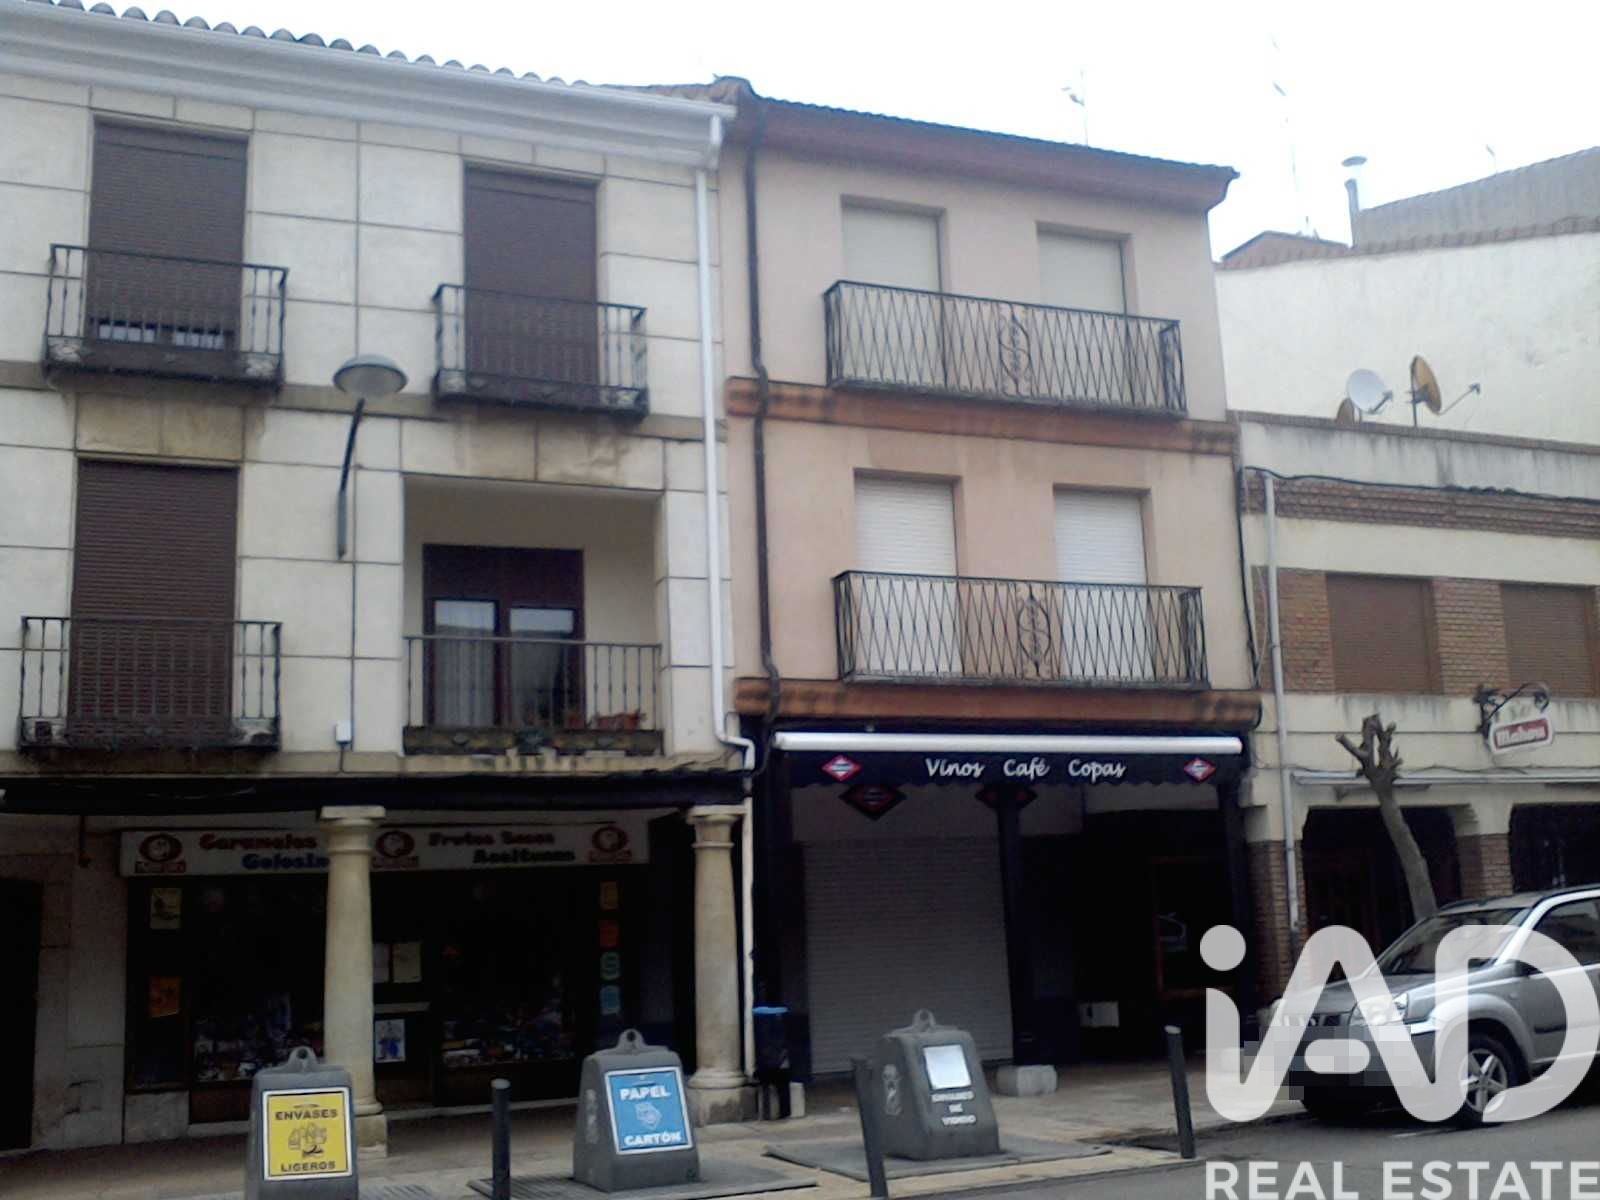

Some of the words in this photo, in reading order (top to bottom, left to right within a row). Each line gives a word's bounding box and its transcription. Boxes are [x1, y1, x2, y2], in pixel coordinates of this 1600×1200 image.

[925, 758, 985, 777] Vinos
[1003, 757, 1050, 781] Café
[1068, 758, 1127, 782] Copas
[242, 853, 329, 870] Golosin
[620, 1085, 672, 1101] PAPEL
[275, 1108, 339, 1121] ENVASES
[624, 1130, 682, 1146] CARTÓN
[281, 1160, 337, 1173] LIGEROS
